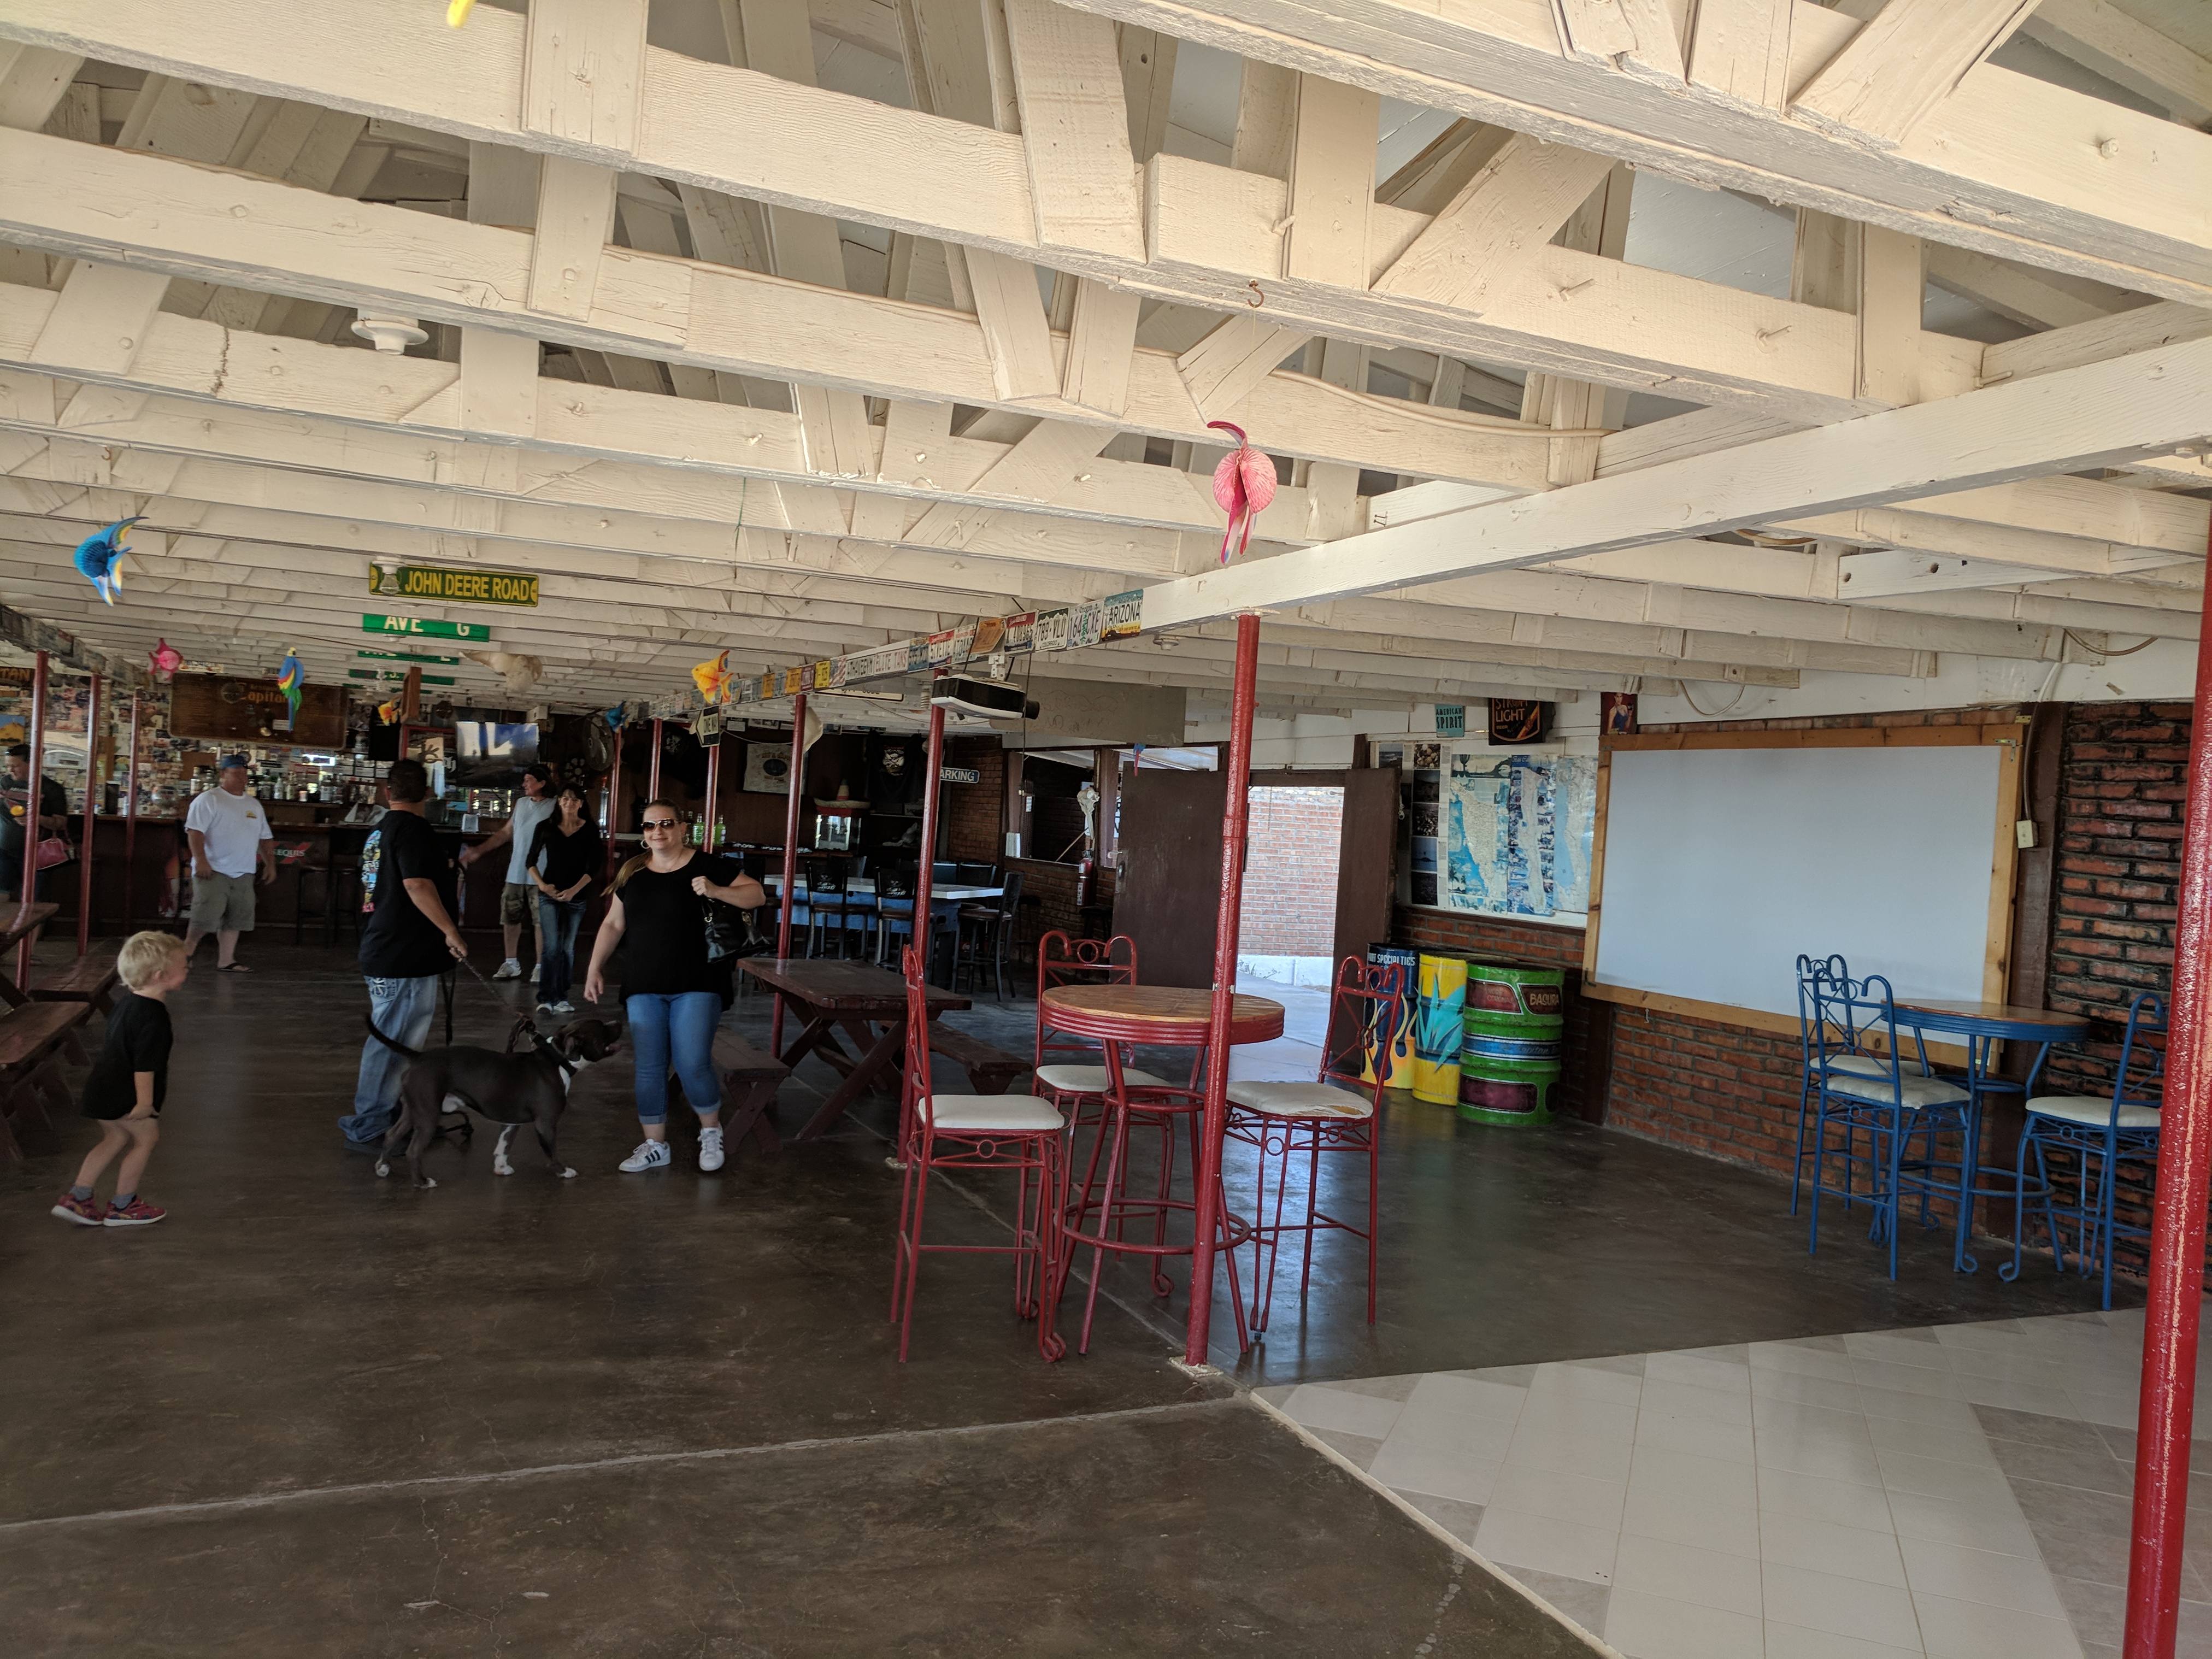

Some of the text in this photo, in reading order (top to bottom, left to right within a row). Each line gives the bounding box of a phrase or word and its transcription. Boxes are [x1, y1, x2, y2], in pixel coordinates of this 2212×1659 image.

[405, 570, 530, 602] JOHN DEERE ROAD
[1108, 601, 1140, 625] ARIZONA
[384, 615, 470, 637] AVE G
[1436, 716, 1462, 729] SPIRIT
[1496, 708, 1525, 722] LIGHT
[940, 769, 975, 781] ARKING
